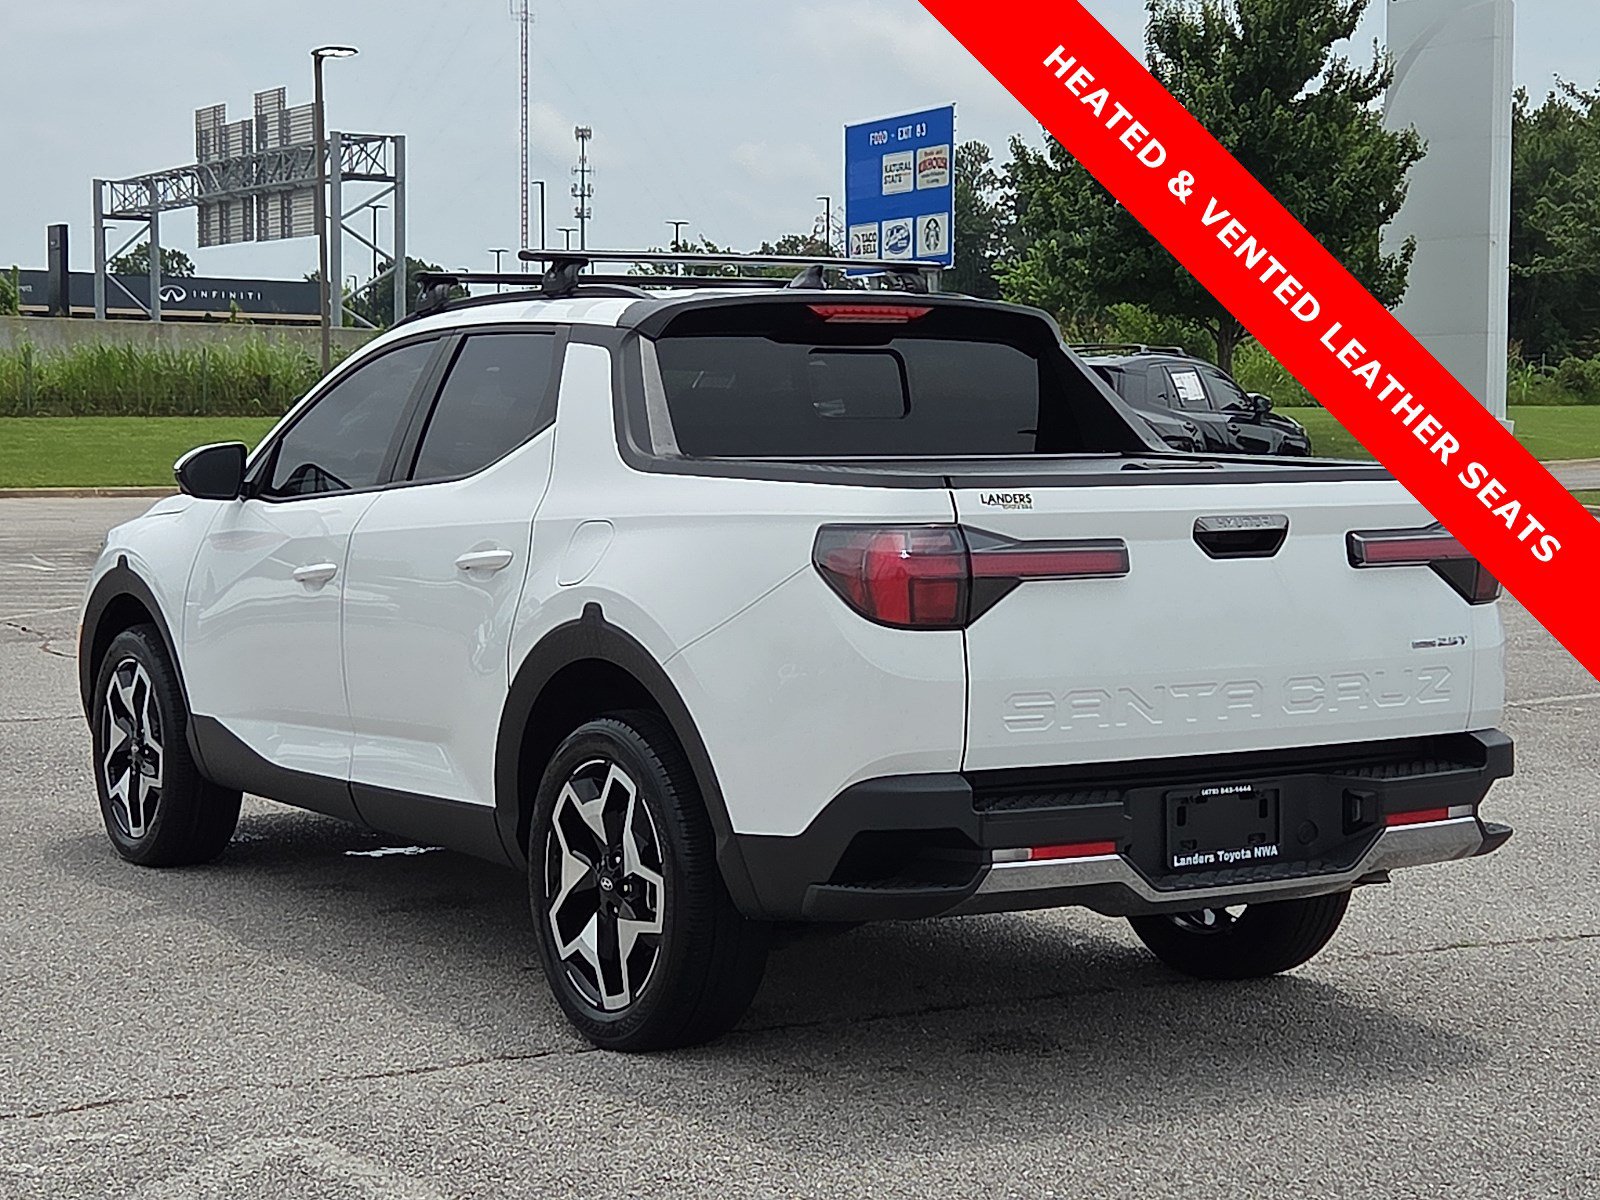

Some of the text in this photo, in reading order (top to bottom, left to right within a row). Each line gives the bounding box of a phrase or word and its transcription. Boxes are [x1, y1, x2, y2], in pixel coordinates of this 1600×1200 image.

[869, 130, 888, 146] FOOD
[897, 125, 913, 141] EXIT
[884, 161, 912, 174] NATURAL
[861, 231, 877, 243] TACO
[862, 243, 877, 255] BELL
[192, 289, 261, 301] INFINITI
[979, 493, 1032, 505] LANDERS
[1002, 665, 1454, 733] SANTA CRUZ
[1173, 845, 1278, 868] Landers Toyota NWA
